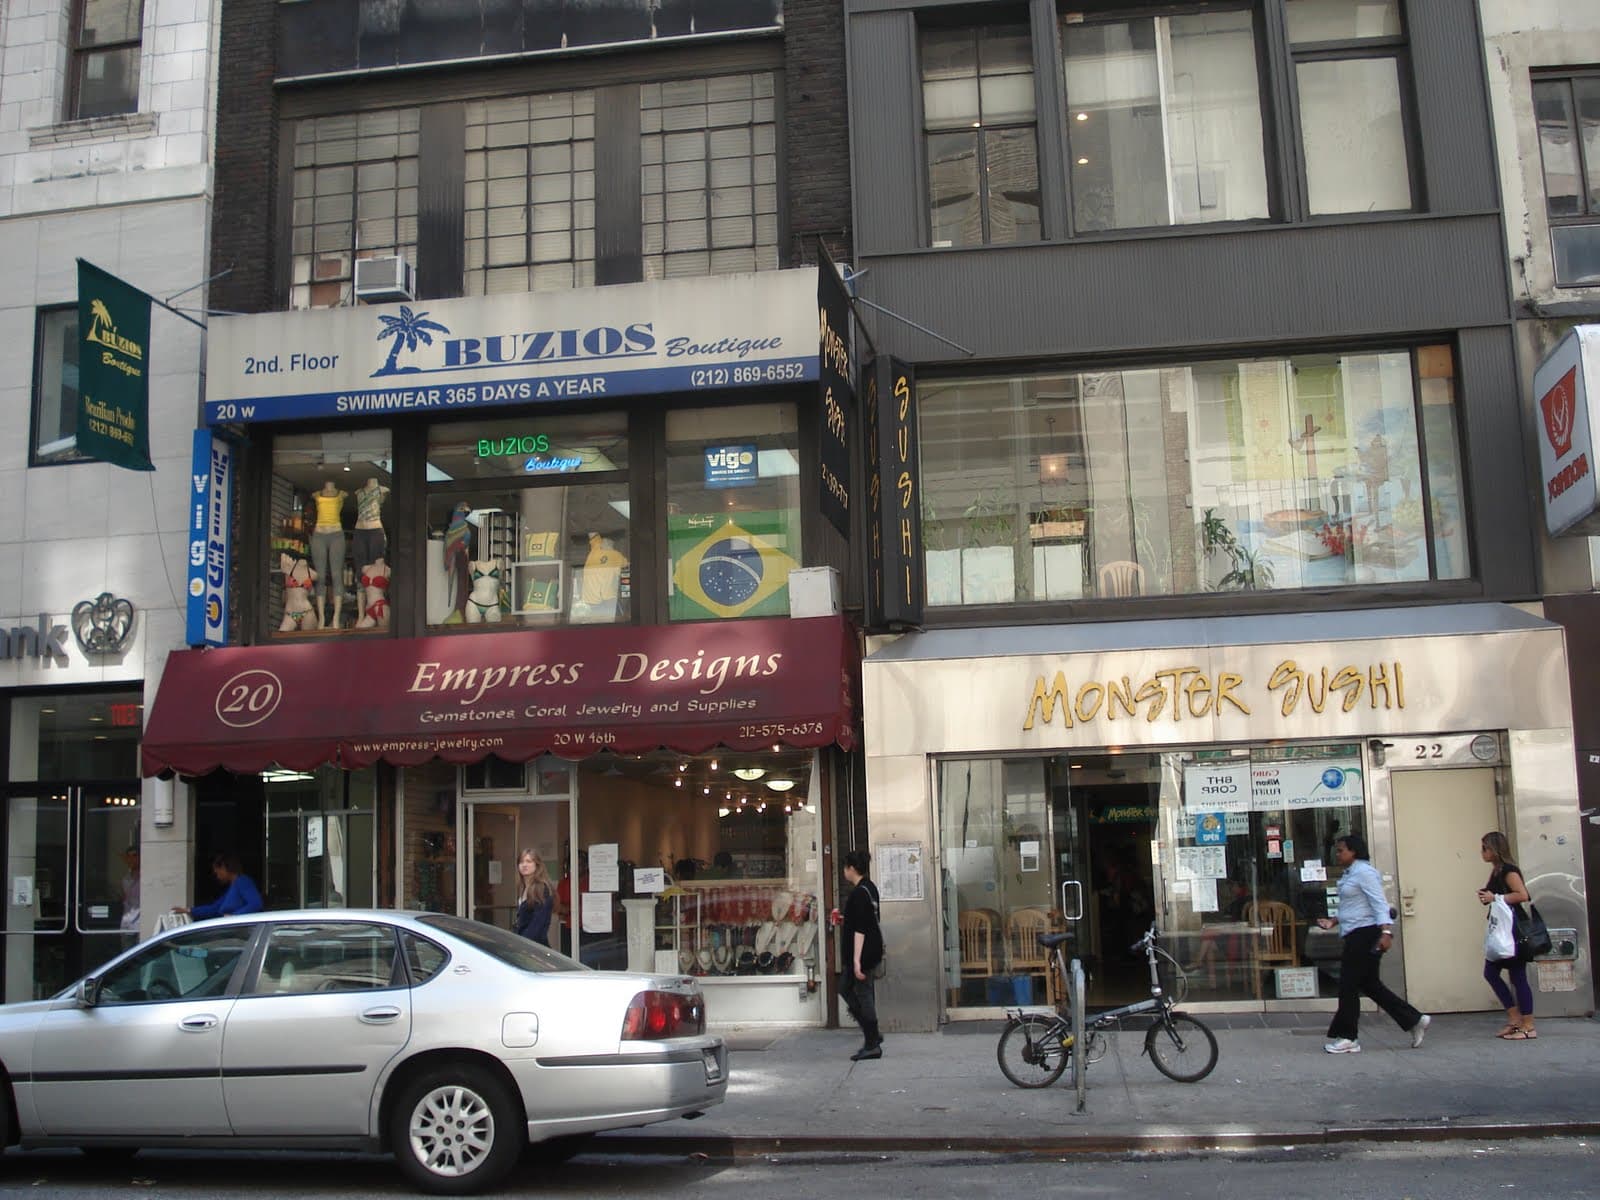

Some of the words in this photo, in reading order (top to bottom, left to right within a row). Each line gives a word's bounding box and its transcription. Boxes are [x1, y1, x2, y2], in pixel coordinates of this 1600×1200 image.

[440, 323, 656, 367] BUZIOS
[664, 336, 783, 358] Boutique
[244, 357, 283, 375] 2nd.
[290, 354, 339, 371] Floor
[691, 368, 729, 386] (212)
[734, 363, 804, 383] 869-6552
[336, 390, 440, 412] SWIMWEAR
[446, 387, 477, 404] 365
[482, 382, 531, 401] DAYS
[536, 384, 550, 397] A
[553, 377, 606, 395] YEAR
[217, 405, 236, 420] 20
[477, 434, 549, 457] BUZIOS
[524, 456, 582, 472] Boutique
[706, 449, 753, 469] vigo
[894, 376, 911, 606] SUSHI
[406, 661, 584, 705] Empress
[608, 650, 783, 695] Designs
[1268, 660, 1406, 717] SUSHI
[223, 684, 274, 712] 20
[420, 709, 516, 724] Gemstones
[524, 705, 567, 718] Coral
[576, 702, 642, 718] Jewelry
[650, 701, 680, 713] and
[687, 698, 757, 714] Supplies
[554, 734, 571, 745] 20
[575, 733, 589, 744] W
[739, 722, 824, 738] 212-575-6378
[353, 737, 504, 753] www.empress-jewelry.com
[1415, 743, 1443, 759] 22
